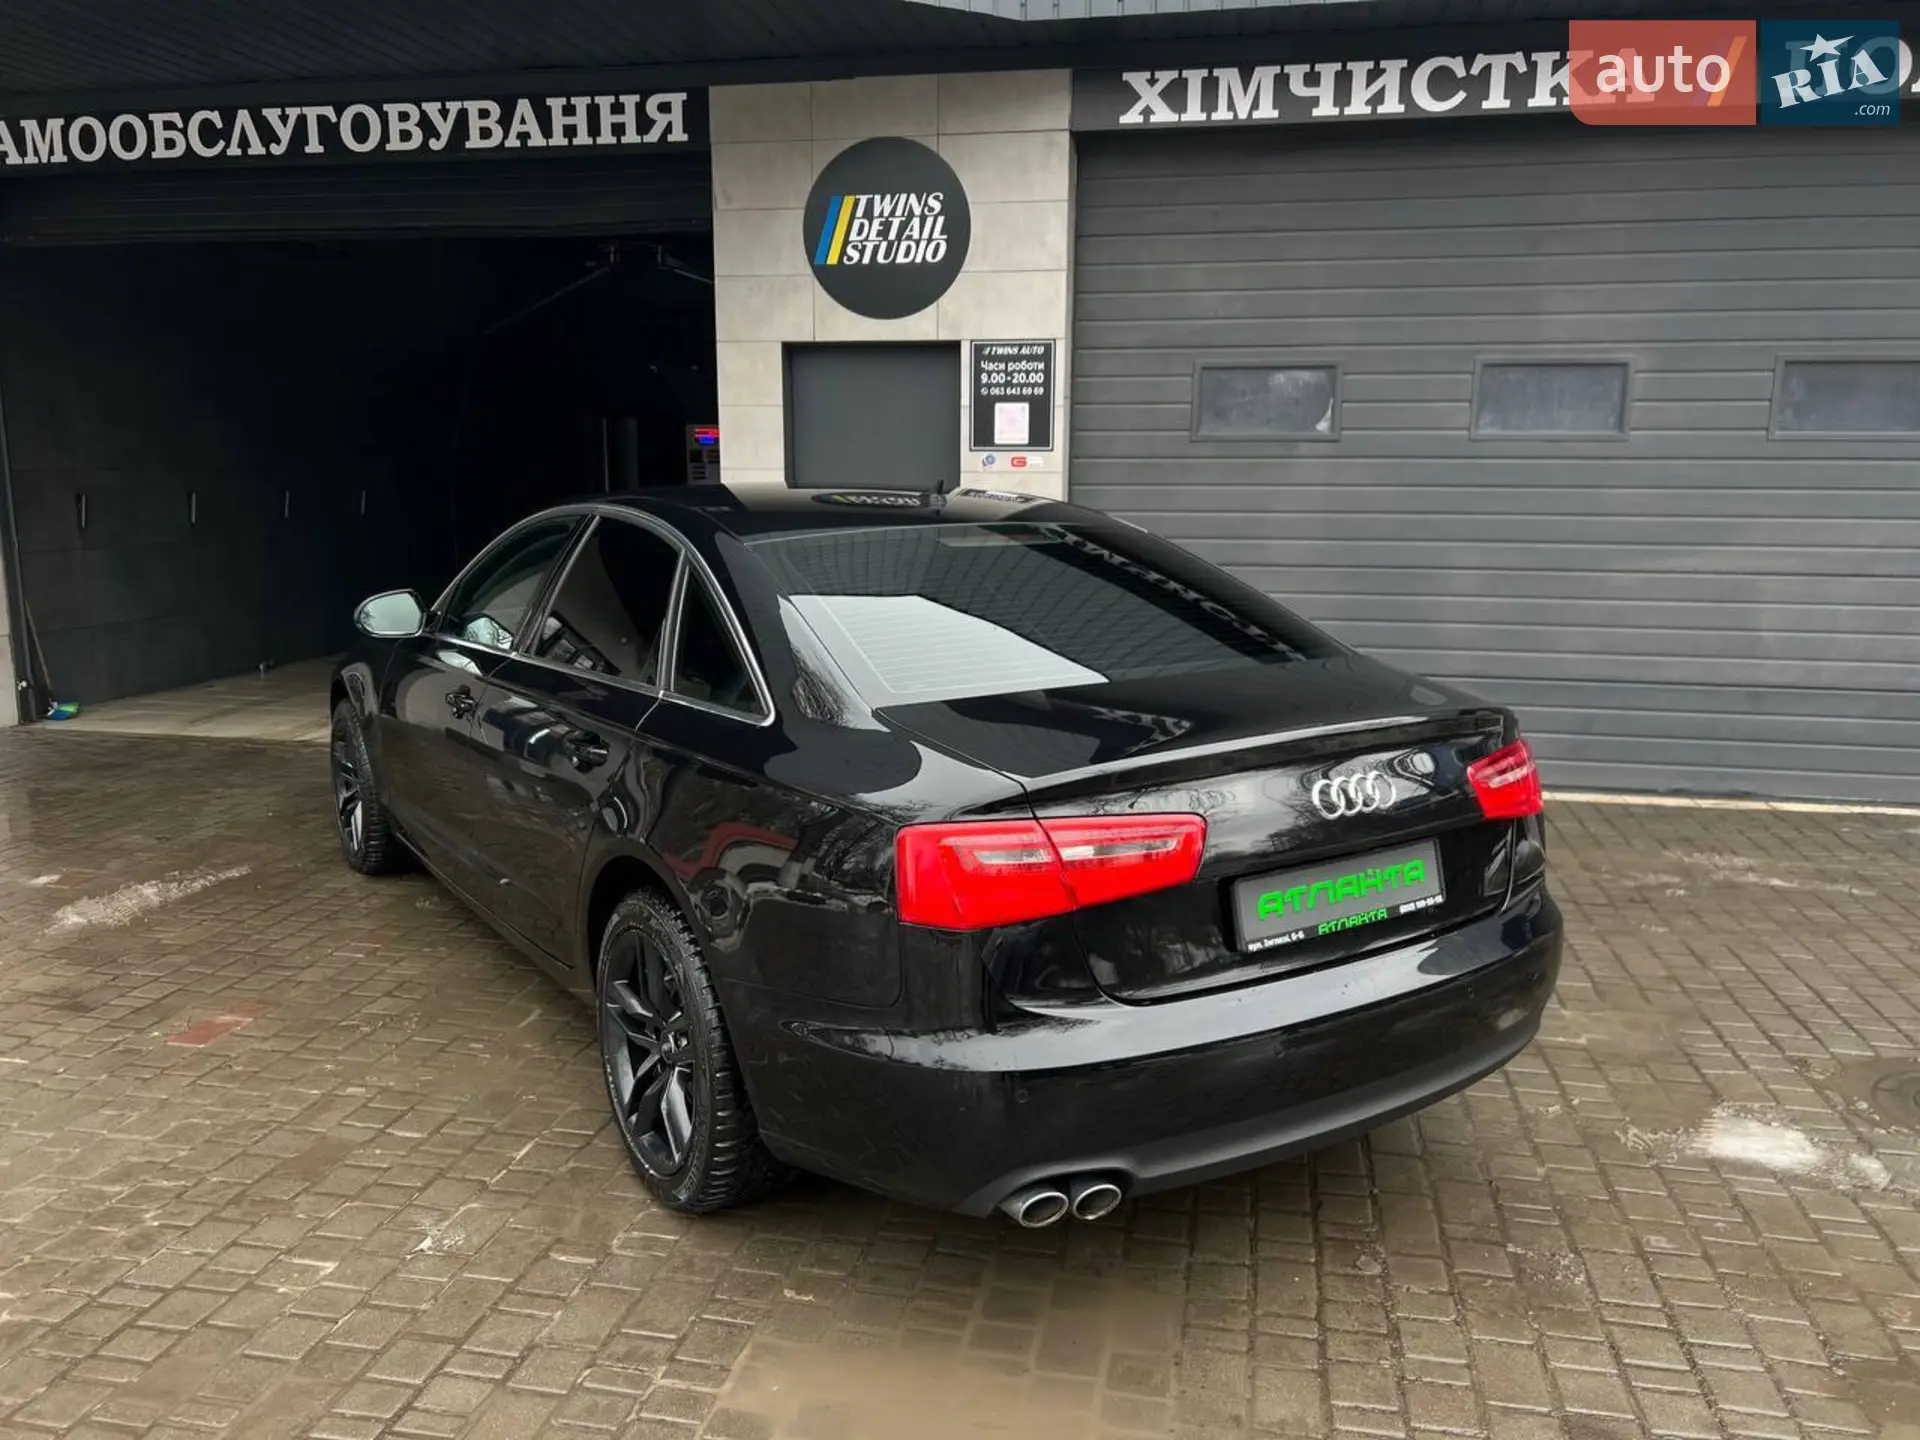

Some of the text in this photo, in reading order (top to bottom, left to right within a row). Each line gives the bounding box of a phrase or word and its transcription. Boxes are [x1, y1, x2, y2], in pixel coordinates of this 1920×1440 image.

[855, 191, 944, 218] TWINS
[848, 215, 948, 242] DETAIL
[842, 239, 947, 265] STUDIO
[991, 345, 1045, 355] TWINS AUTO
[980, 360, 1045, 372] Часи роботи
